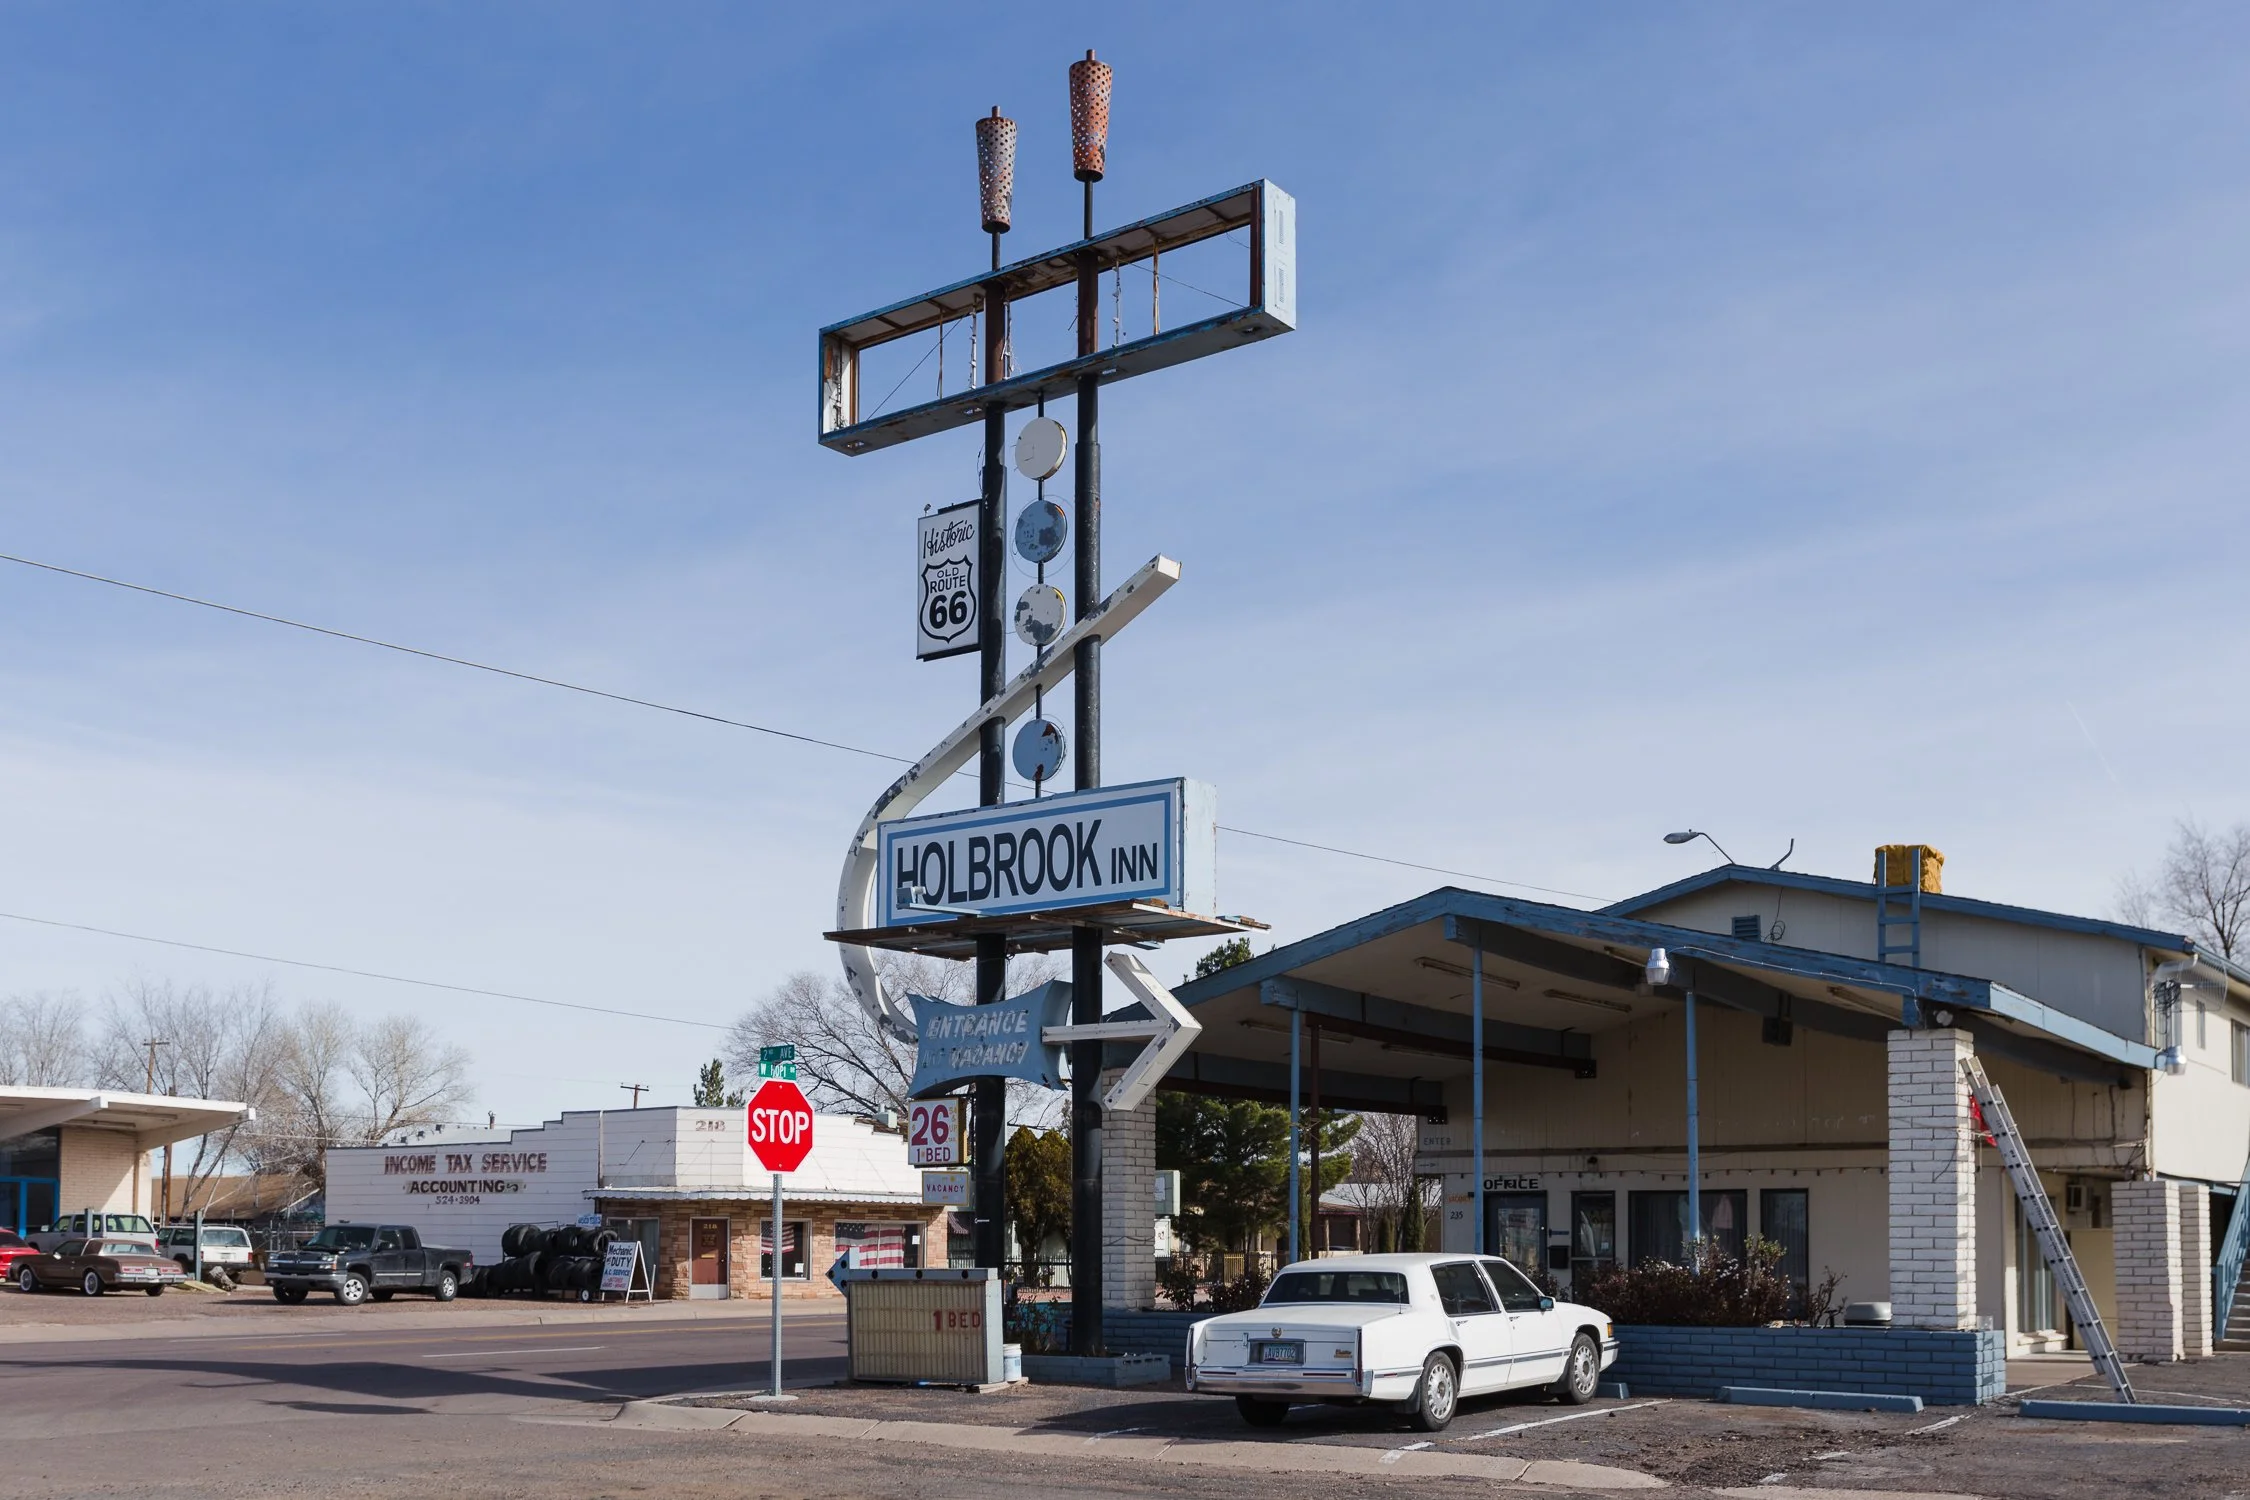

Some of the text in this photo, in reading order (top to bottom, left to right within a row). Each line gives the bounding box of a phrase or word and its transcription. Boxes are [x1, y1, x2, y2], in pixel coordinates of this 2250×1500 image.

[922, 519, 976, 559] Historic
[936, 567, 960, 579] OLD
[929, 575, 966, 594] ROUTE
[929, 590, 968, 630] 66
[897, 819, 1158, 907] HOLBROOK INN
[925, 1009, 1029, 1040] ENTRANCE
[780, 1046, 793, 1059] AVE
[760, 1062, 767, 1076] W
[752, 1107, 810, 1145] STOP
[926, 1147, 951, 1162] BED
[384, 1152, 548, 1175] INCOME TAX SERVICE
[409, 1179, 505, 1194] ACCOUNTING
[926, 1183, 965, 1193] VACANCY
[1450, 1211, 1464, 1220] 235
[608, 1244, 633, 1256] Mechanic
[610, 1256, 633, 1267] DUTY
[933, 1310, 981, 1331] 1 BED
